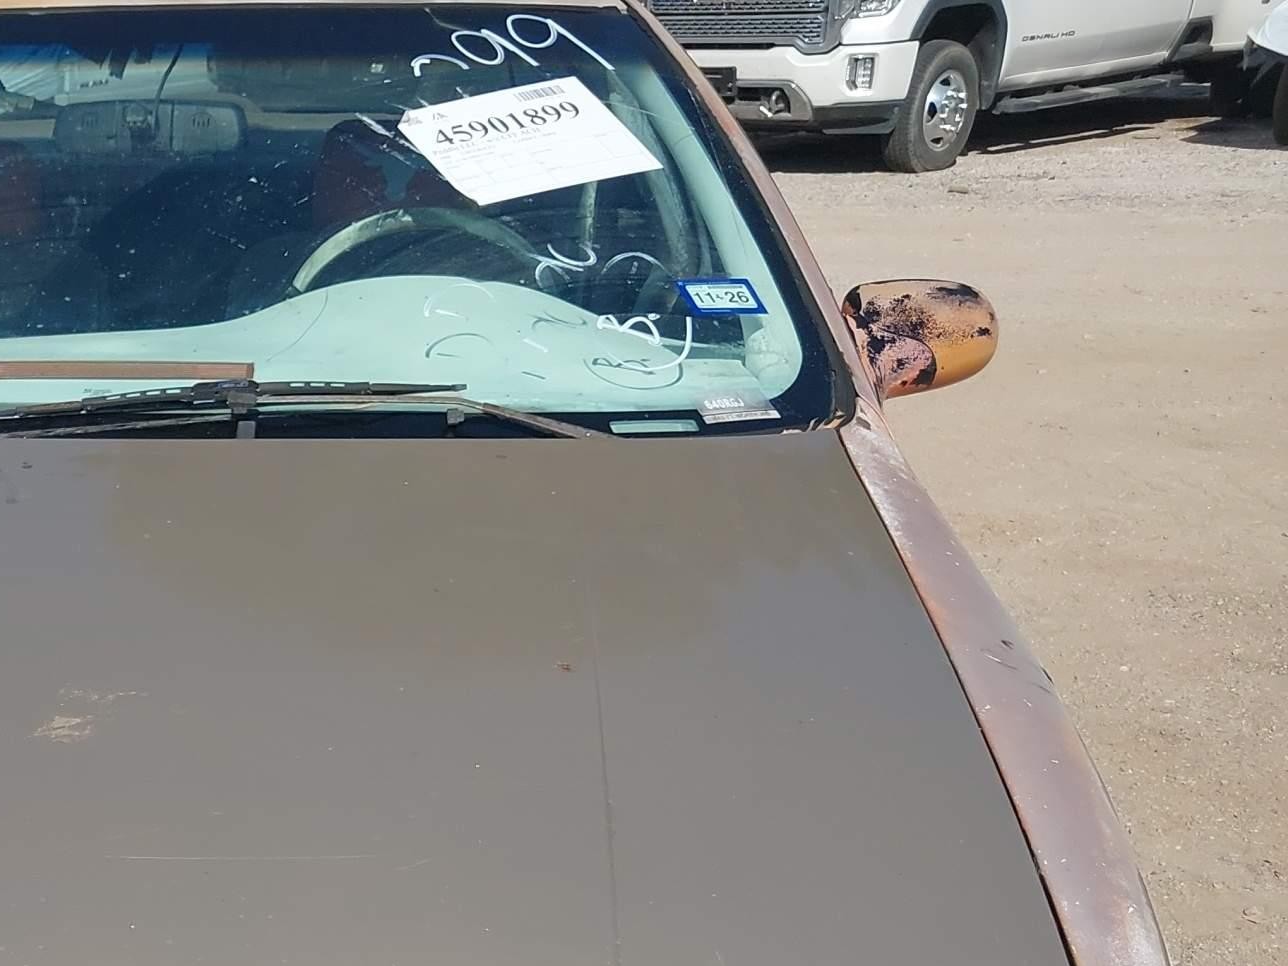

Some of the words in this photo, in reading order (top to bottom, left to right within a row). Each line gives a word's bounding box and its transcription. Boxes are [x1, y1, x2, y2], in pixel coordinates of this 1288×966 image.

[1021, 32, 1060, 42] DENALI
[1061, 30, 1076, 38] HD
[435, 101, 580, 145] 45901899
